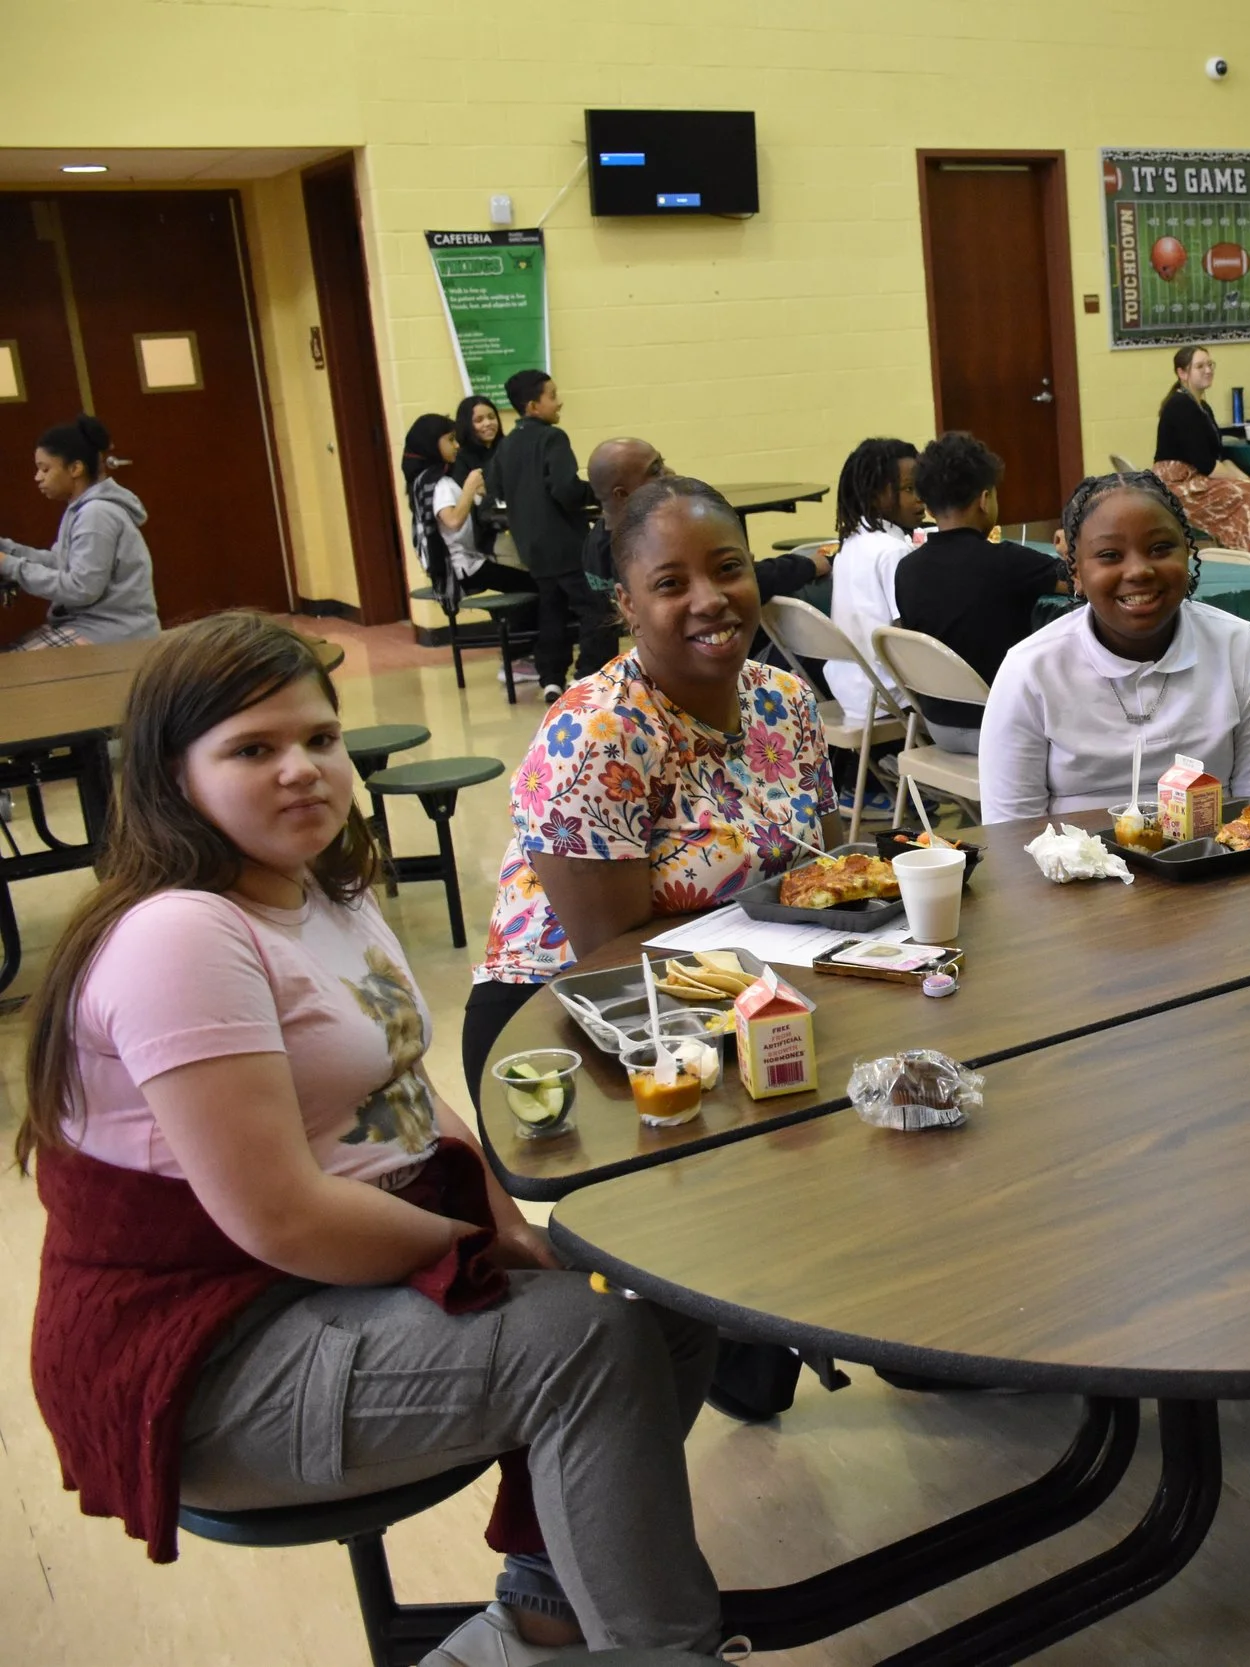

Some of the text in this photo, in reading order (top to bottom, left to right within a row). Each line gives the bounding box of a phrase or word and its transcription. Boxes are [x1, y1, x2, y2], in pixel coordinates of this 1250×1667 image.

[1132, 166, 1178, 193] IT'S
[1184, 167, 1248, 194] GAME
[434, 233, 492, 246] CAFETERIA
[1120, 209, 1139, 323] TOUCHDOWN
[772, 1024, 790, 1034] FREE
[763, 1035, 803, 1050] ARTIFICIAL
